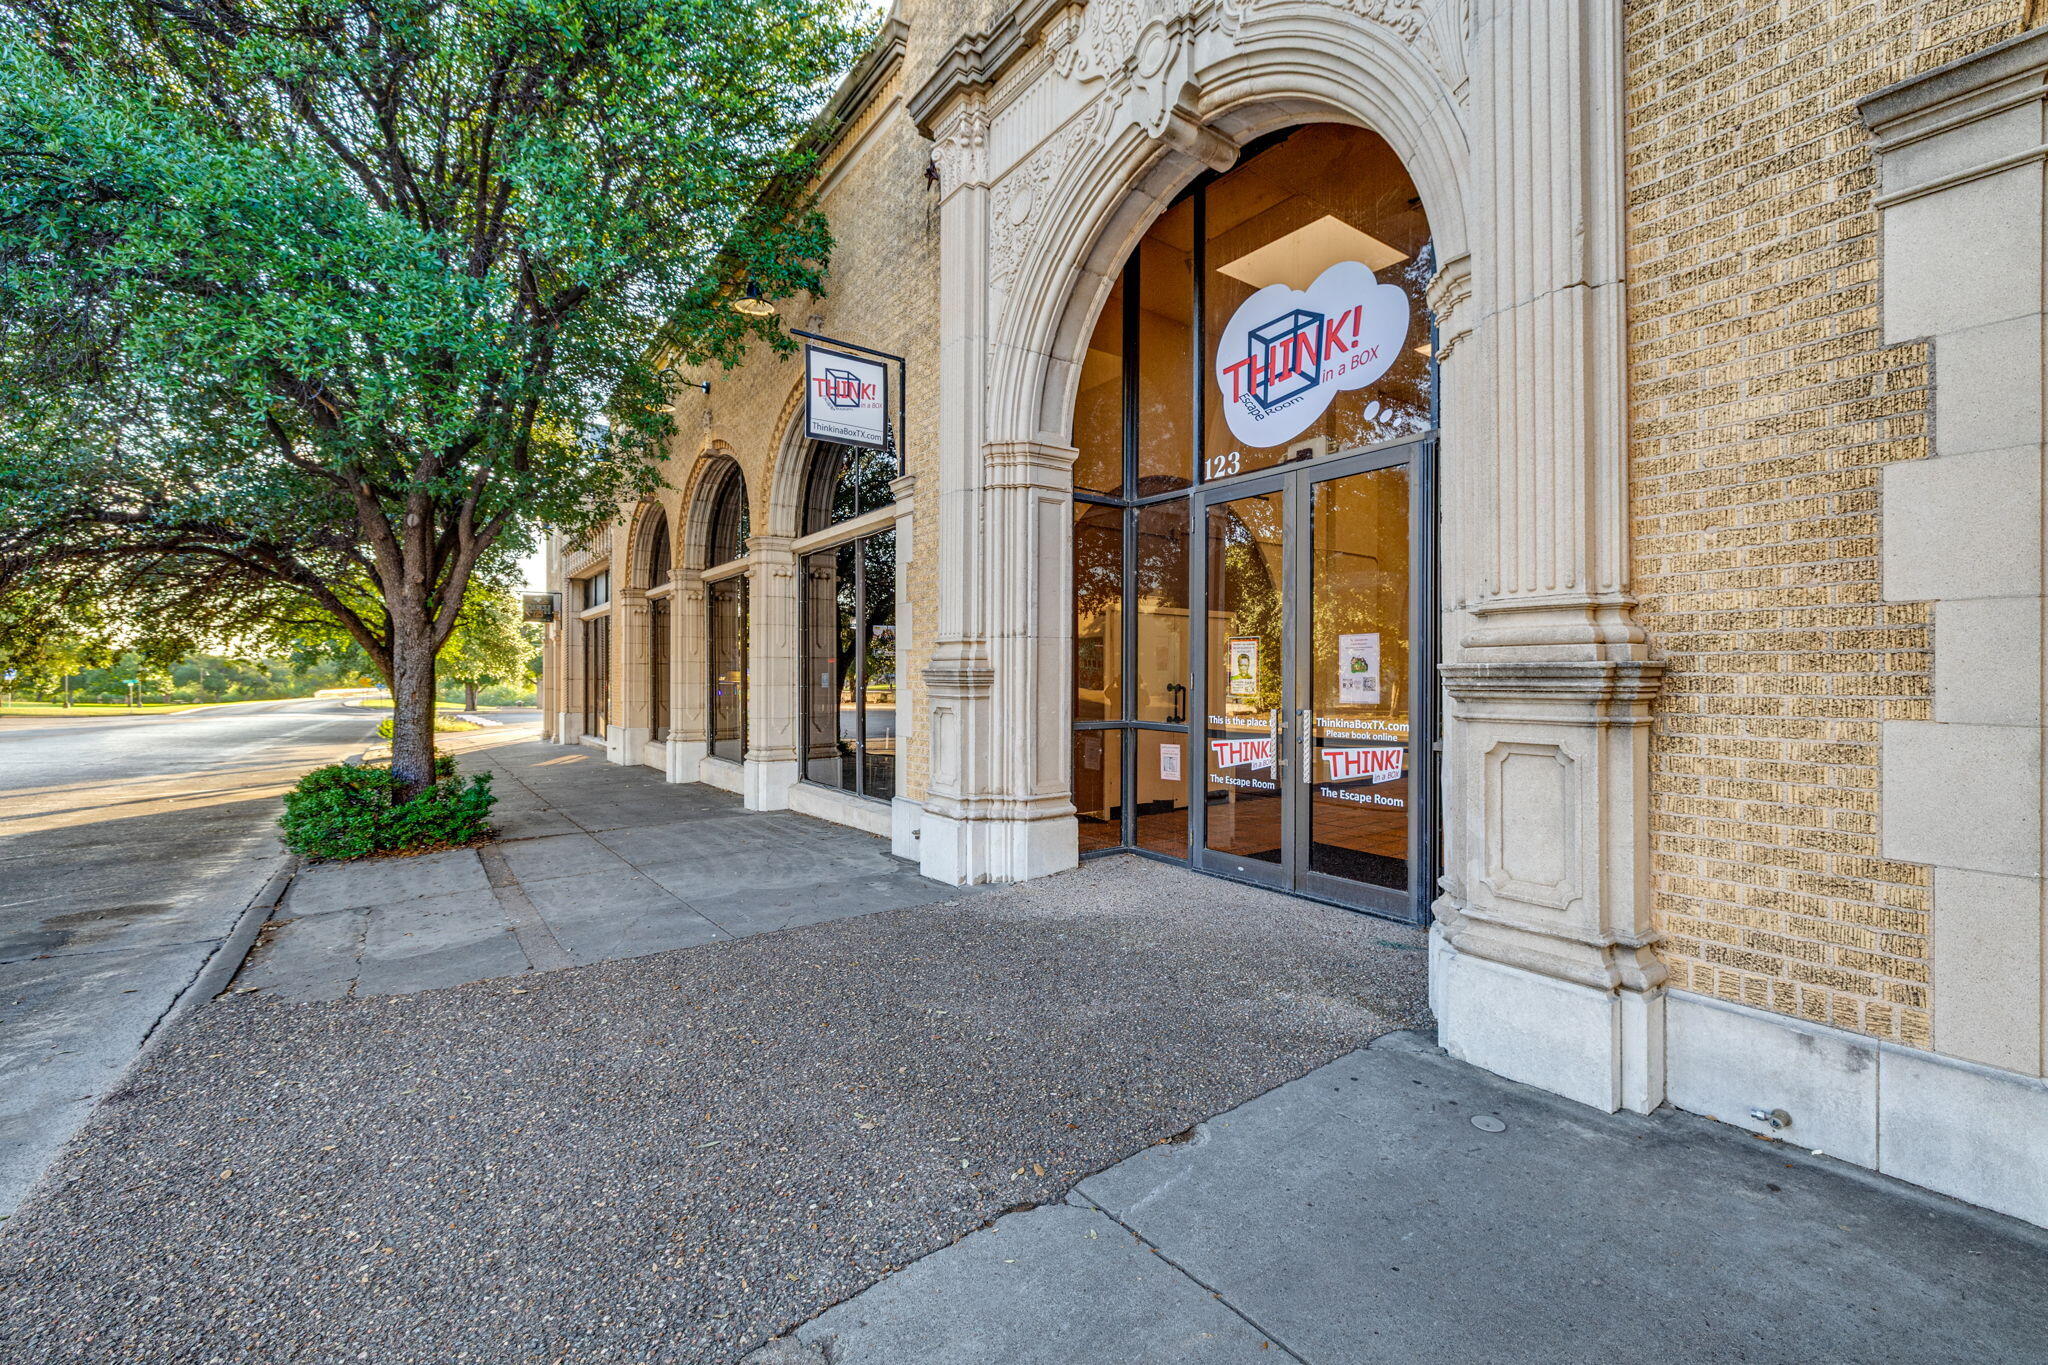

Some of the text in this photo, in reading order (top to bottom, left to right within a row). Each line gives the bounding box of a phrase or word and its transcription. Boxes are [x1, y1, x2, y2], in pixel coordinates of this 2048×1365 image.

[1223, 305, 1362, 403] THINK!
[1322, 344, 1380, 384] in a BOX
[812, 378, 876, 400] THINK!
[1239, 393, 1265, 421] Escape
[1265, 396, 1304, 416] Room
[812, 422, 882, 440] ThinkinaBoxTX.com
[1205, 451, 1241, 480] 123
[1208, 715, 1224, 724] This
[1225, 716, 1231, 725] is
[1232, 716, 1246, 725] the
[1247, 717, 1267, 727] place
[1315, 717, 1409, 732] ThinkinaBoxTX.com
[1326, 729, 1398, 742] Please book online
[1213, 741, 1272, 765] THINK!
[1323, 750, 1401, 777] THINK!
[1210, 773, 1275, 790] The Escape Room
[1387, 770, 1400, 780] BOX
[1320, 787, 1404, 808] The Escape Room
